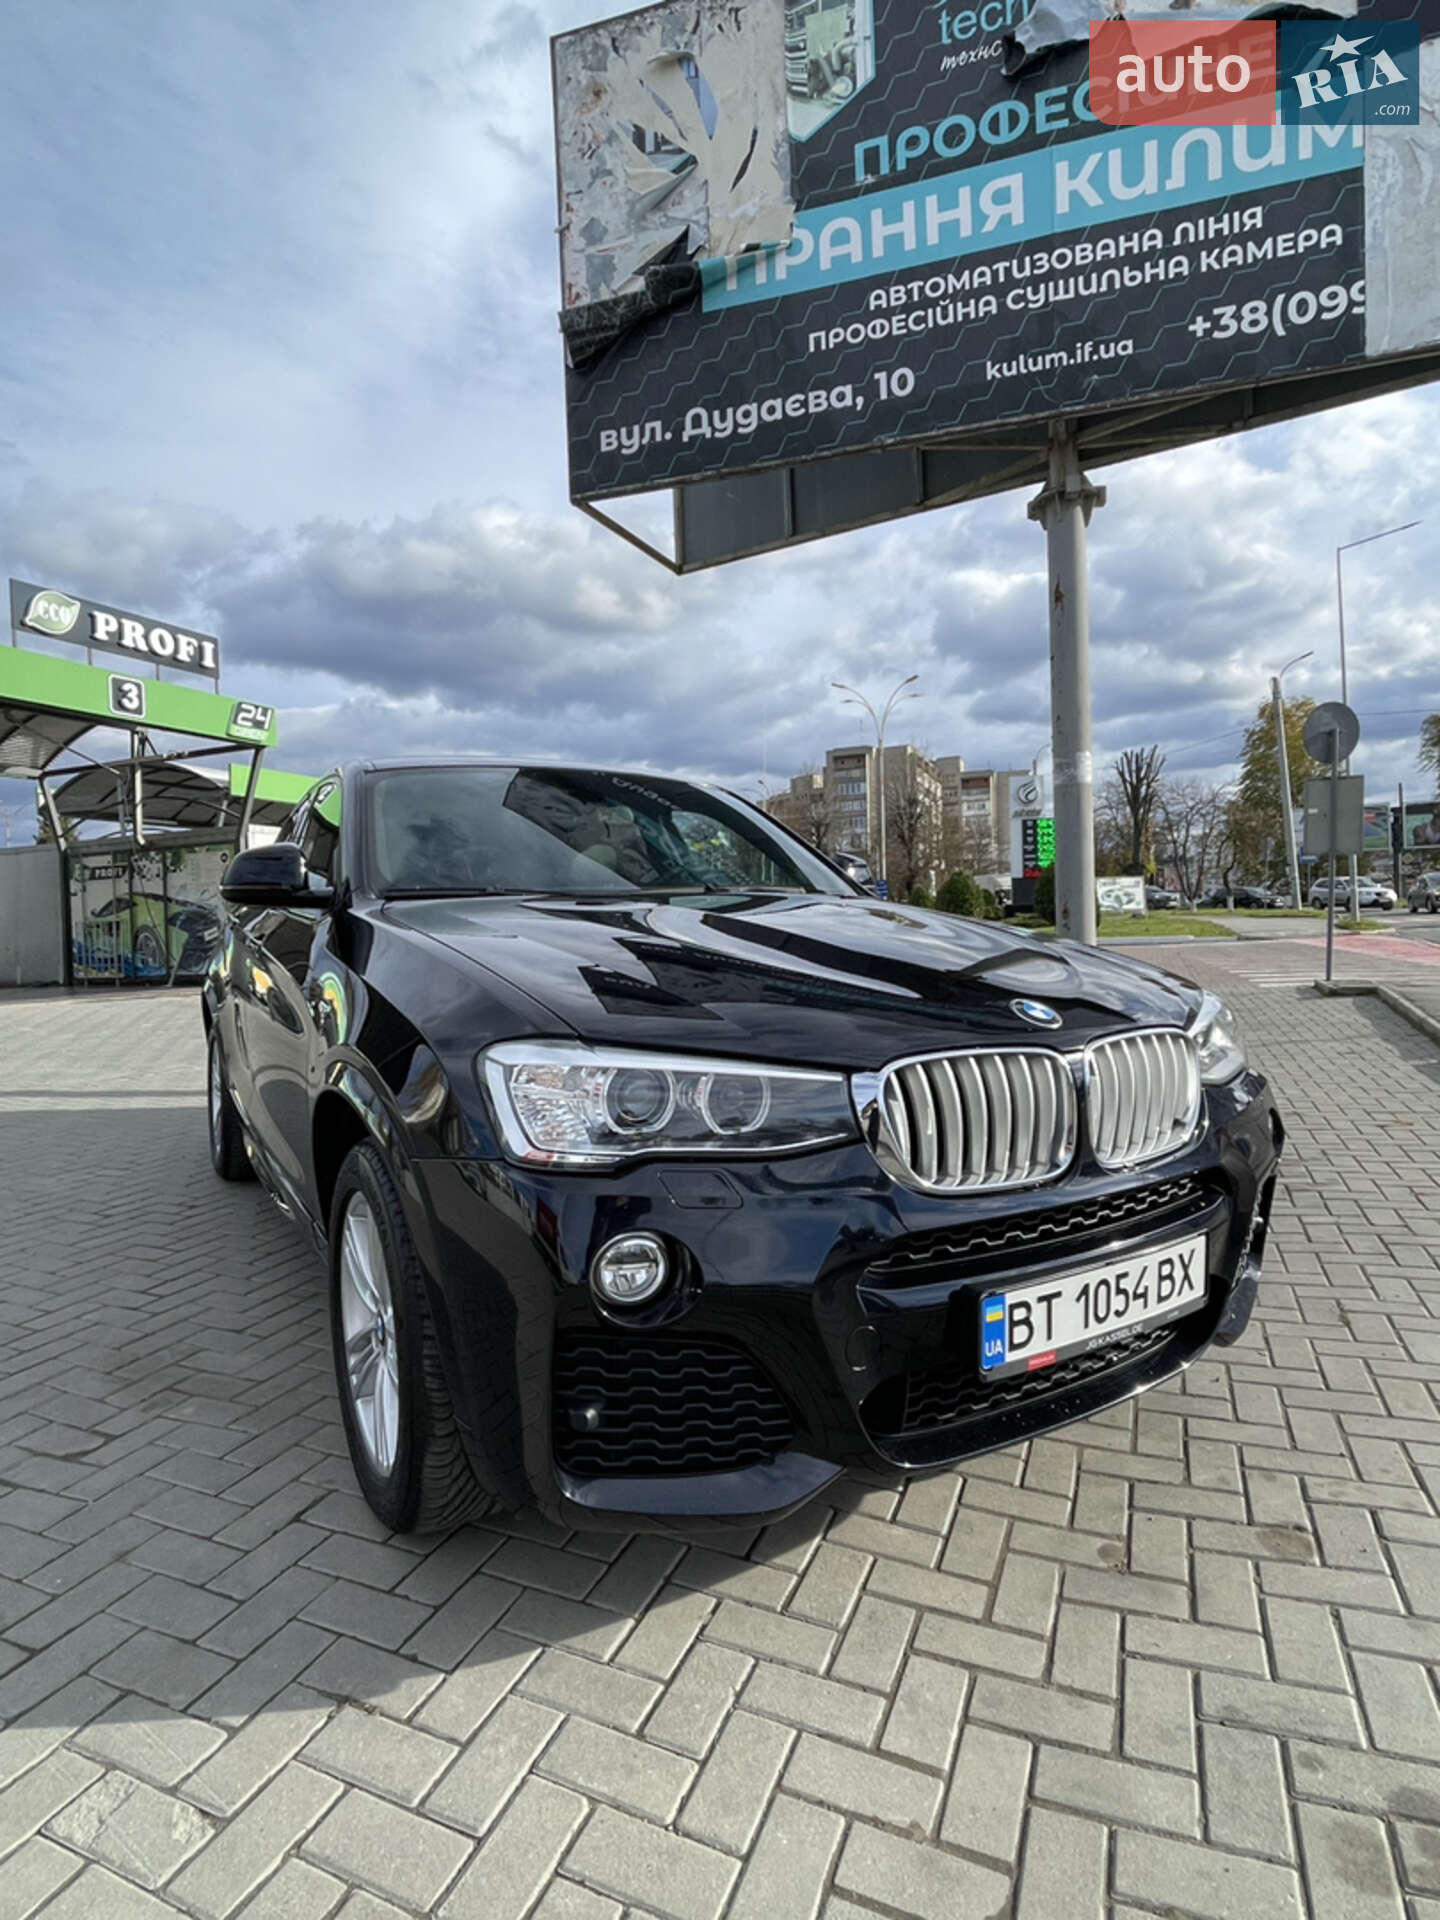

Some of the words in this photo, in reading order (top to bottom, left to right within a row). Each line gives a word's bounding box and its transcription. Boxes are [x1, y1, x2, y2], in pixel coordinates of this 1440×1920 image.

[869, 227, 1163, 311] АВТОМАТИЗОВАНА
[1172, 205, 1264, 247] ЛІНІЯ
[808, 294, 998, 353] ПРОФЕСІЙНА
[1005, 254, 1190, 311] СУШИЛЬНА
[1200, 223, 1343, 273] КАМЕРА
[985, 339, 1134, 381] kulum.if.ua
[600, 419, 673, 455] вул.
[682, 382, 865, 442] Дудаєва,
[874, 366, 916, 401] 10
[90, 610, 216, 669] PROFI
[119, 683, 140, 710] 3
[237, 703, 271, 729] 24
[1008, 1290, 1062, 1353] BT
[1076, 1265, 1150, 1330] 1054
[1156, 1248, 1196, 1305] BX
[984, 1339, 1004, 1357] UA
